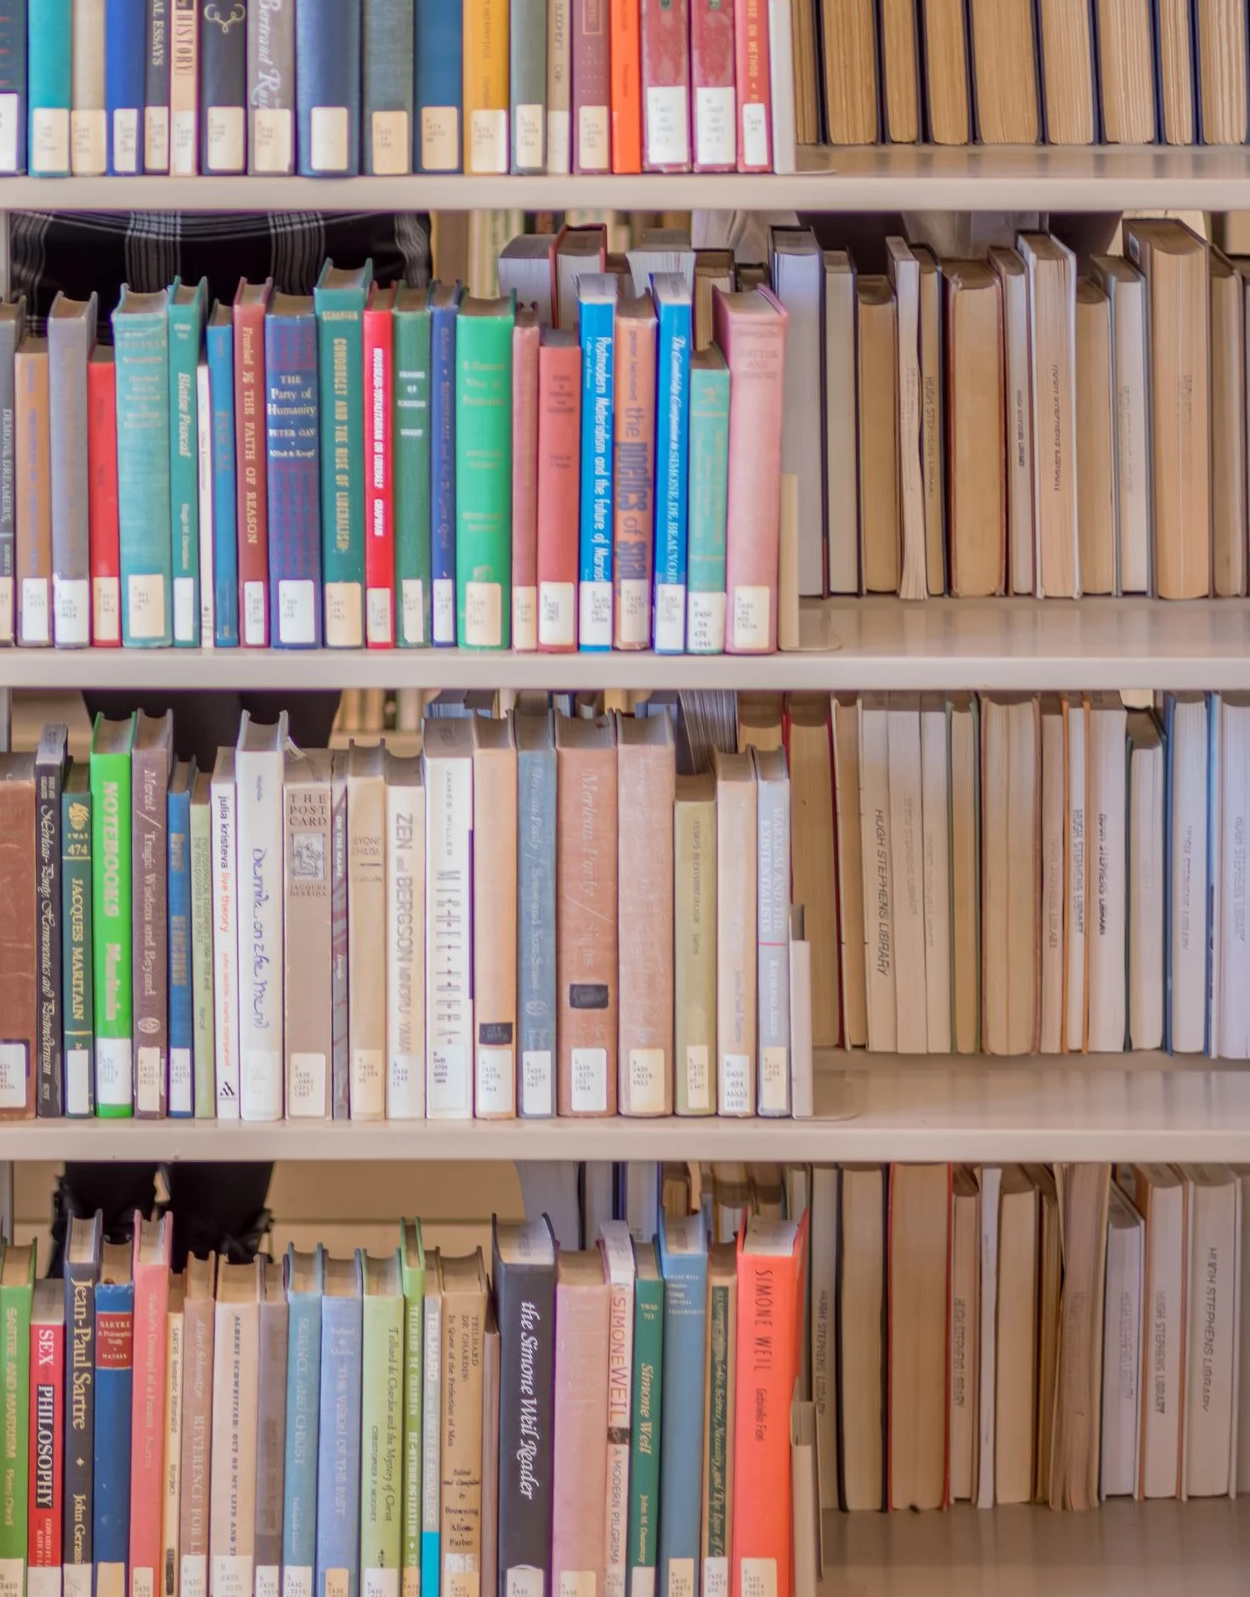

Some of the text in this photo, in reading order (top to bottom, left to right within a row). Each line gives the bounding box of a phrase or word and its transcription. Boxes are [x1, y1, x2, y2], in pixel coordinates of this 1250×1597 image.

[67, 844, 88, 856] 474
[102, 780, 120, 918] NOTEBOOKS
[217, 795, 230, 933] julia kristeva live theory
[289, 794, 327, 804] THE
[289, 804, 326, 815] POST
[289, 816, 327, 827] CARD
[71, 878, 85, 1020] JACQUES MARITAIN
[71, 1278, 92, 1431] Jean-Paul Sartre
[753, 1269, 772, 1372] SIMONE WEIL
[36, 1328, 54, 1507] SEX PHILOSOPHY
[516, 1301, 540, 1500] the Simone Weil Reader
